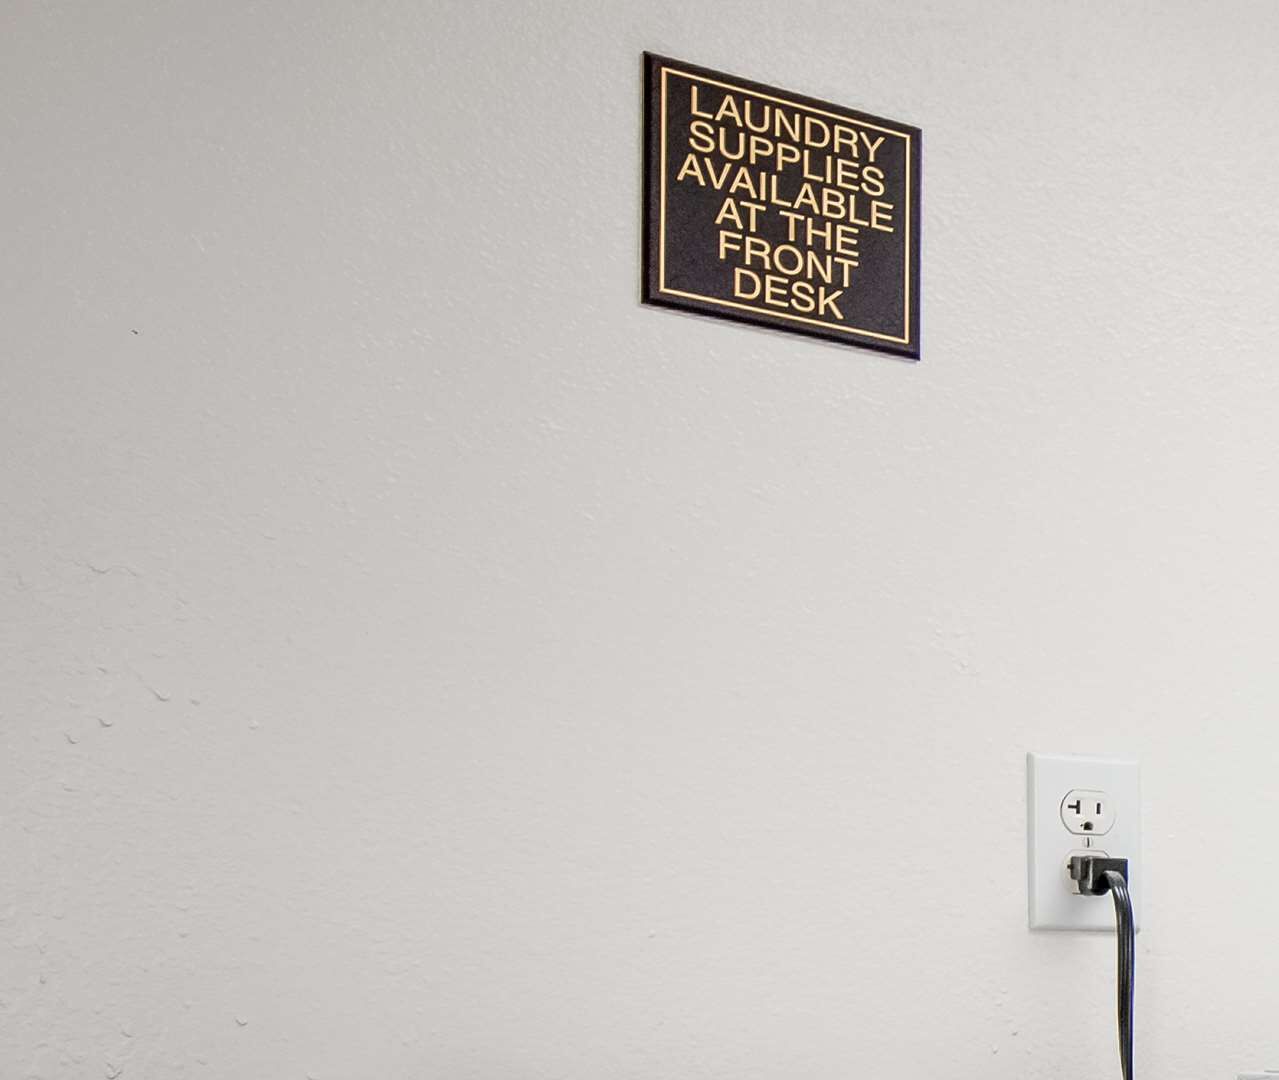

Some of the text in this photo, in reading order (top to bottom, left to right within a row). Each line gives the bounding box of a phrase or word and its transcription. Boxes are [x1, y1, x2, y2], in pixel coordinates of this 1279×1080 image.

[691, 86, 885, 162] LAUNDRY
[689, 121, 885, 196] SUPPLIES
[677, 154, 894, 232] AVAILABLE
[715, 198, 860, 257] AT THE
[719, 230, 859, 288] FRONT
[734, 267, 844, 319] DESK
